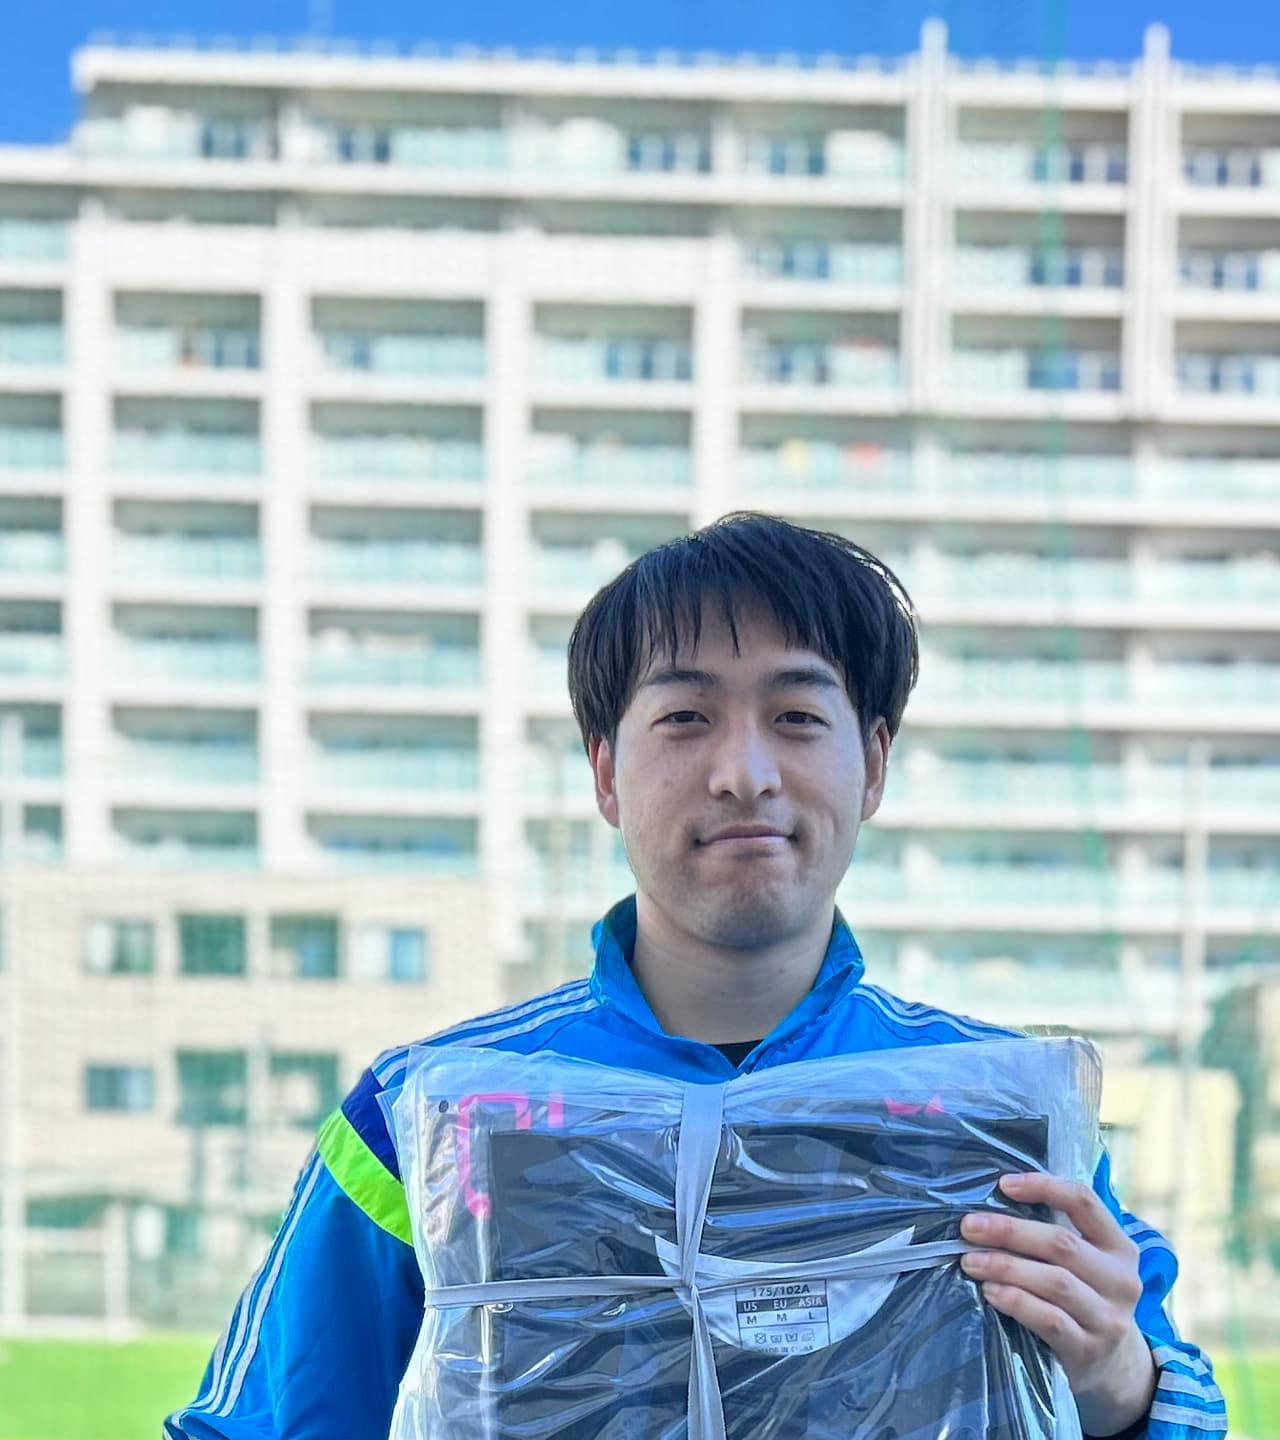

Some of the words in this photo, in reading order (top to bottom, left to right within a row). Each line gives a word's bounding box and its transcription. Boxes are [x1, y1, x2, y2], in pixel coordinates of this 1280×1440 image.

[752, 1284, 810, 1297] 175/102A
[743, 1302, 758, 1312] US
[773, 1299, 788, 1310] EU
[798, 1296, 823, 1307] ASIA
[746, 1315, 757, 1325] M
[776, 1313, 787, 1322] M
[808, 1311, 815, 1320] L
